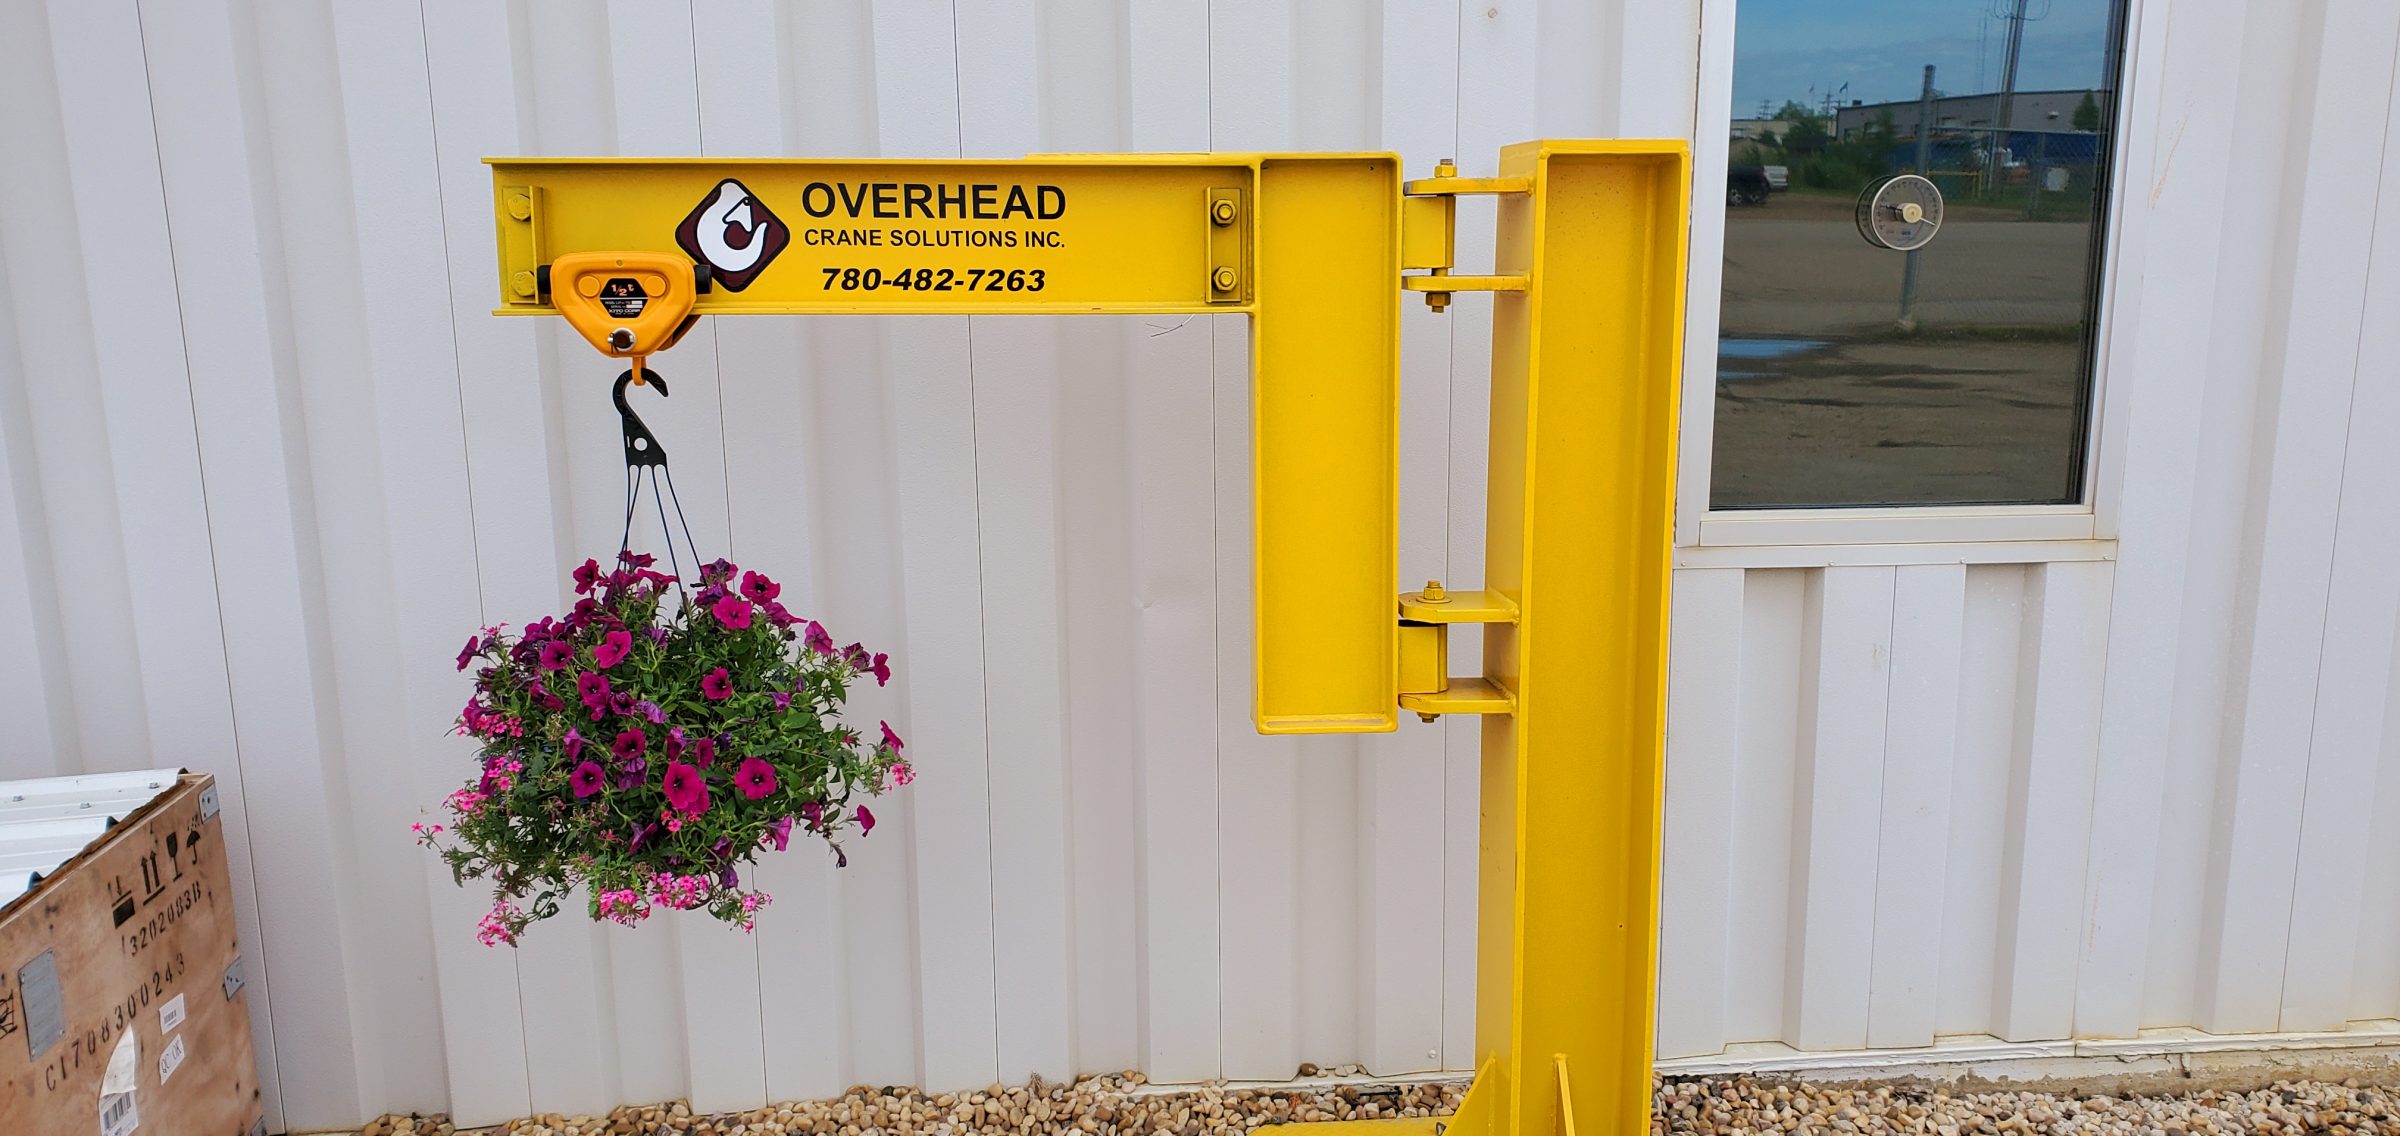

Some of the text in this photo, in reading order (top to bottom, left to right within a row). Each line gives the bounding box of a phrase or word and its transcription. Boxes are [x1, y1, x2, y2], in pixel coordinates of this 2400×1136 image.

[802, 182, 1066, 220] OVERHEAD
[804, 229, 1065, 248] CRANE SOLUTIONS INC.
[821, 268, 1046, 291] 780-482-7263
